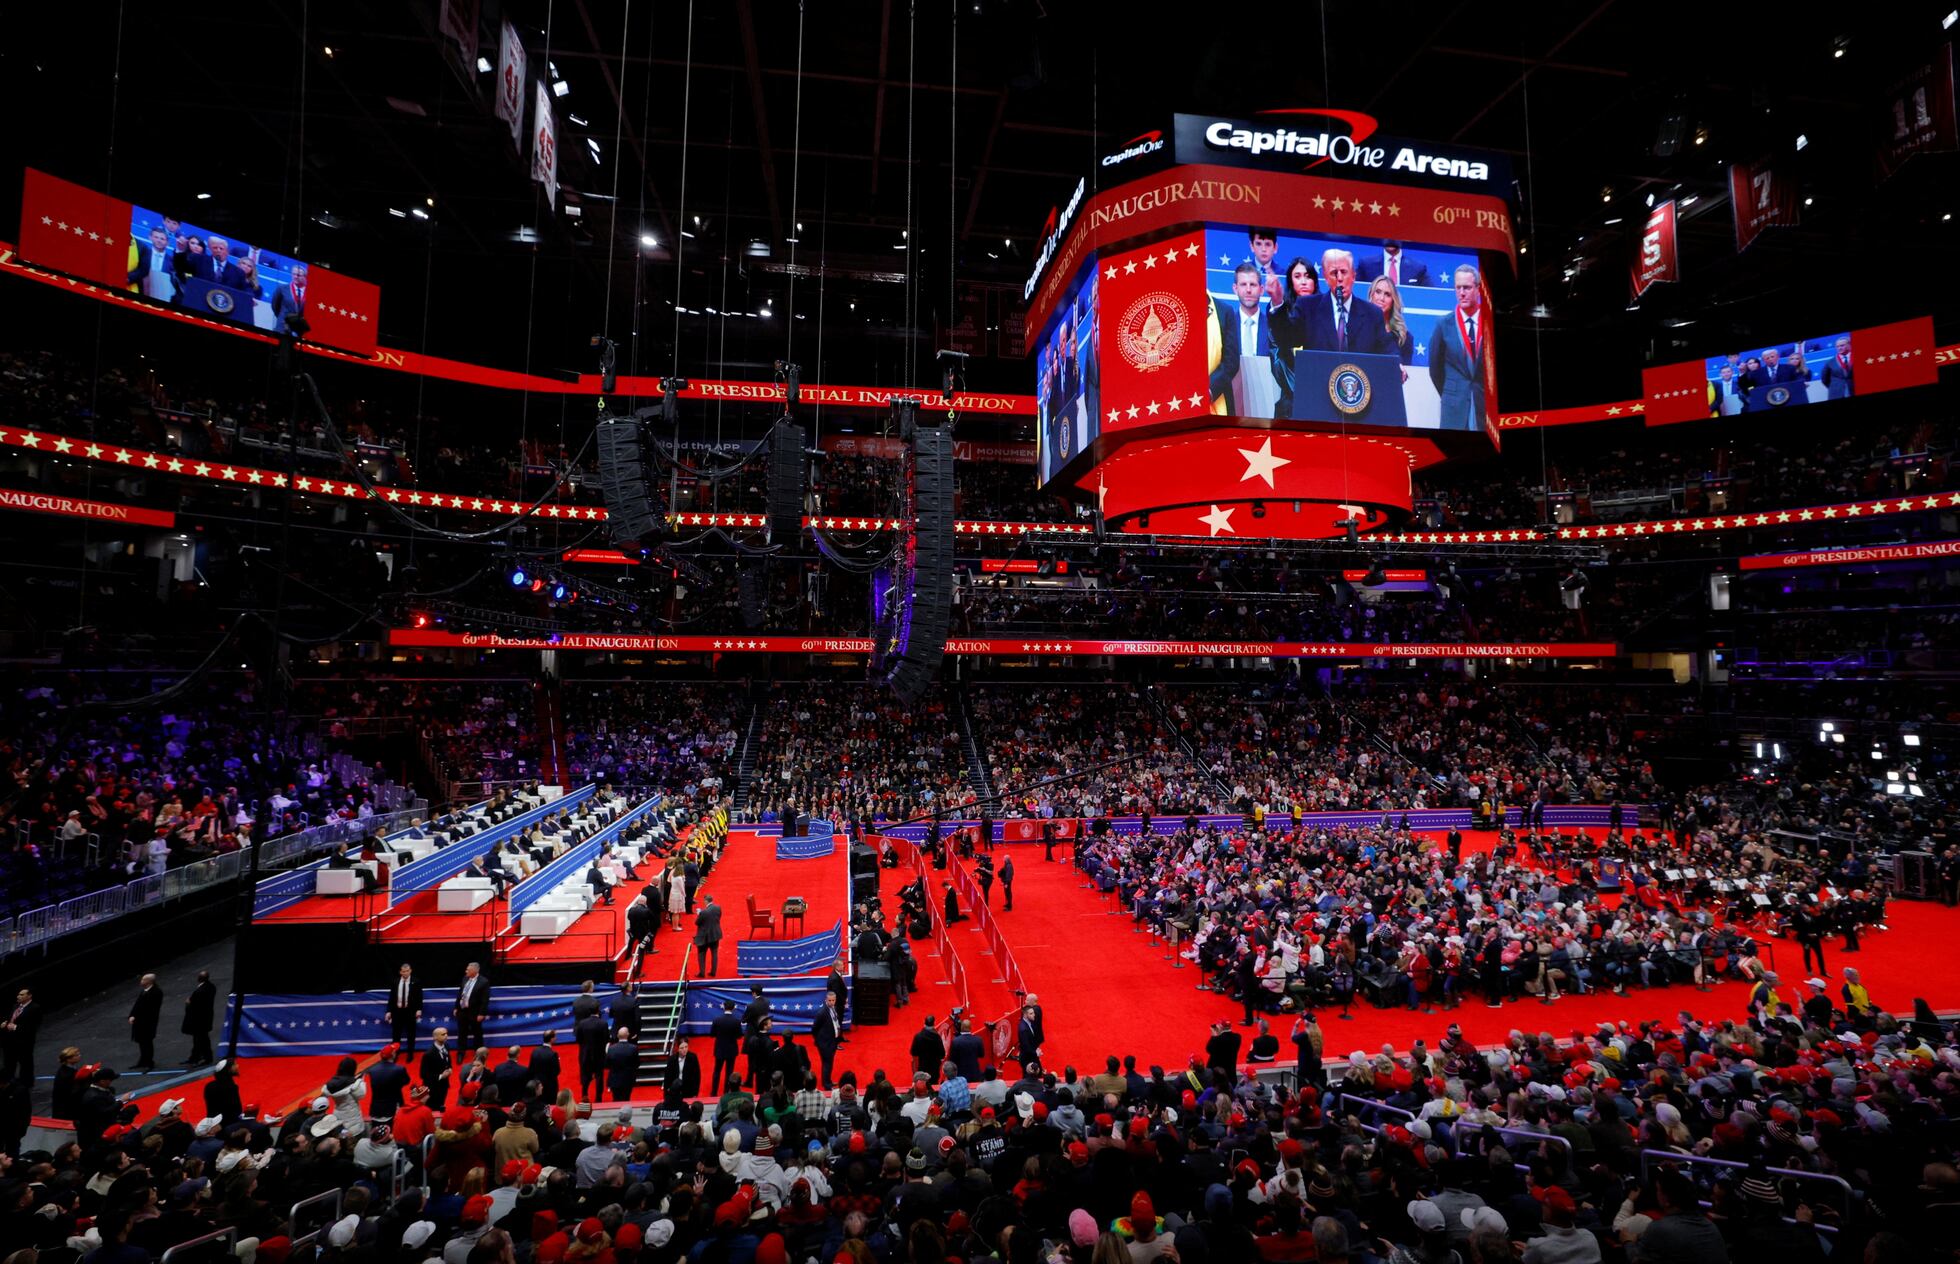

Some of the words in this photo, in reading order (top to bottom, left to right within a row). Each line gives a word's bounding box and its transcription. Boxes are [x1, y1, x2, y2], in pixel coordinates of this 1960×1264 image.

[1892, 86, 1932, 141] 11
[1391, 148, 1489, 181] Arena
[1753, 169, 1772, 210] 7
[1058, 176, 1085, 239] Arena
[1090, 181, 1261, 230] INAUGURATION
[1433, 205, 1471, 225] 60TH
[1643, 231, 1661, 266] 5
[701, 383, 851, 401] PRESIDETIAL
[1810, 548, 1912, 563] PRESIDENTIAL
[585, 637, 679, 649] INAUGURATION
[1124, 643, 1196, 654] PRESIDENTIAL
[1198, 645, 1273, 654] INAUGURATION
[1392, 646, 1464, 655] PRESIDENTIAL
[1466, 646, 1549, 656] INAUGURATION
[980, 1138, 1005, 1152] STAND
